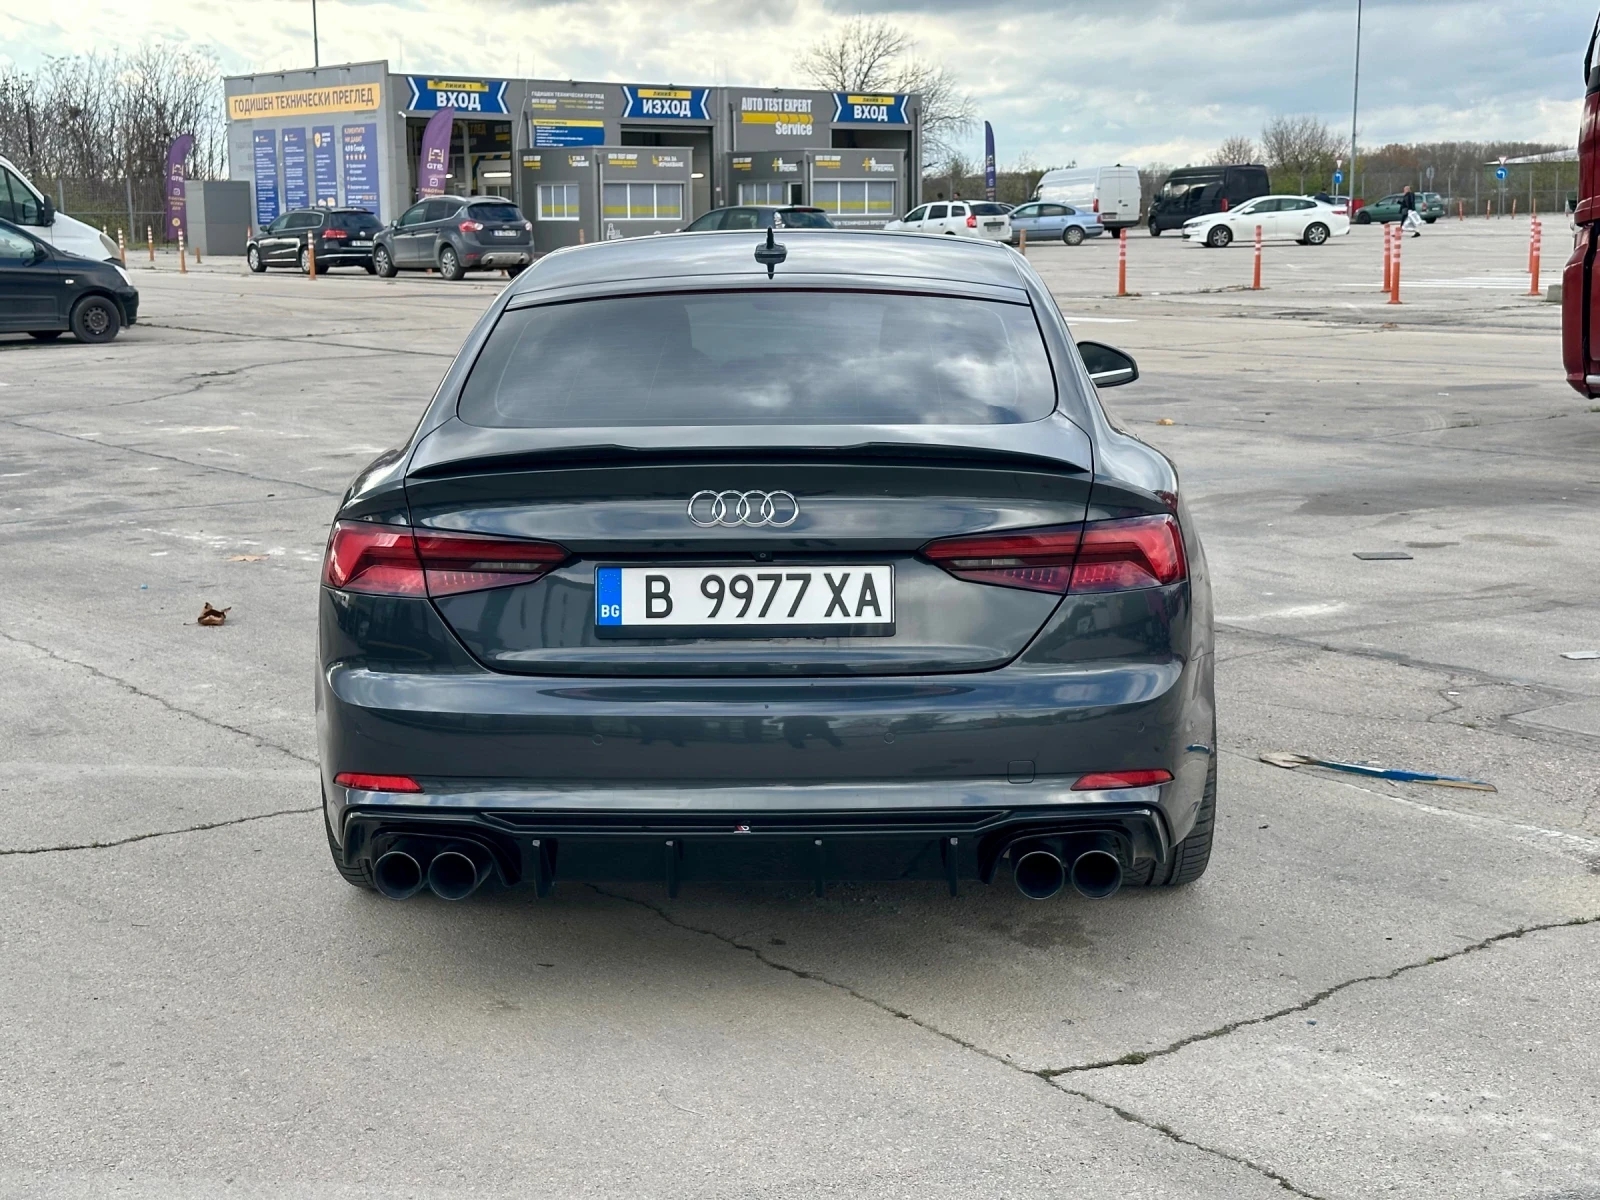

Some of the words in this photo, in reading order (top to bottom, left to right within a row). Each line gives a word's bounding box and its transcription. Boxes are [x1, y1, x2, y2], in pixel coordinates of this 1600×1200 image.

[234, 96, 274, 116] ГОДИШЕН
[275, 92, 330, 110] ТЕХНИЧЕСКИ
[332, 87, 374, 106] ПРЕГЛЕД
[436, 91, 481, 111] ВХОД
[642, 98, 691, 118] ИЗХОД
[741, 96, 763, 111] AUTO
[763, 97, 783, 112] TEST
[783, 98, 813, 113] EXPERT
[853, 105, 888, 122] ВХОД
[775, 121, 813, 136] Service
[645, 574, 673, 618] B
[700, 573, 812, 618] 9977
[823, 573, 883, 617] XA
[601, 605, 620, 618] BG
